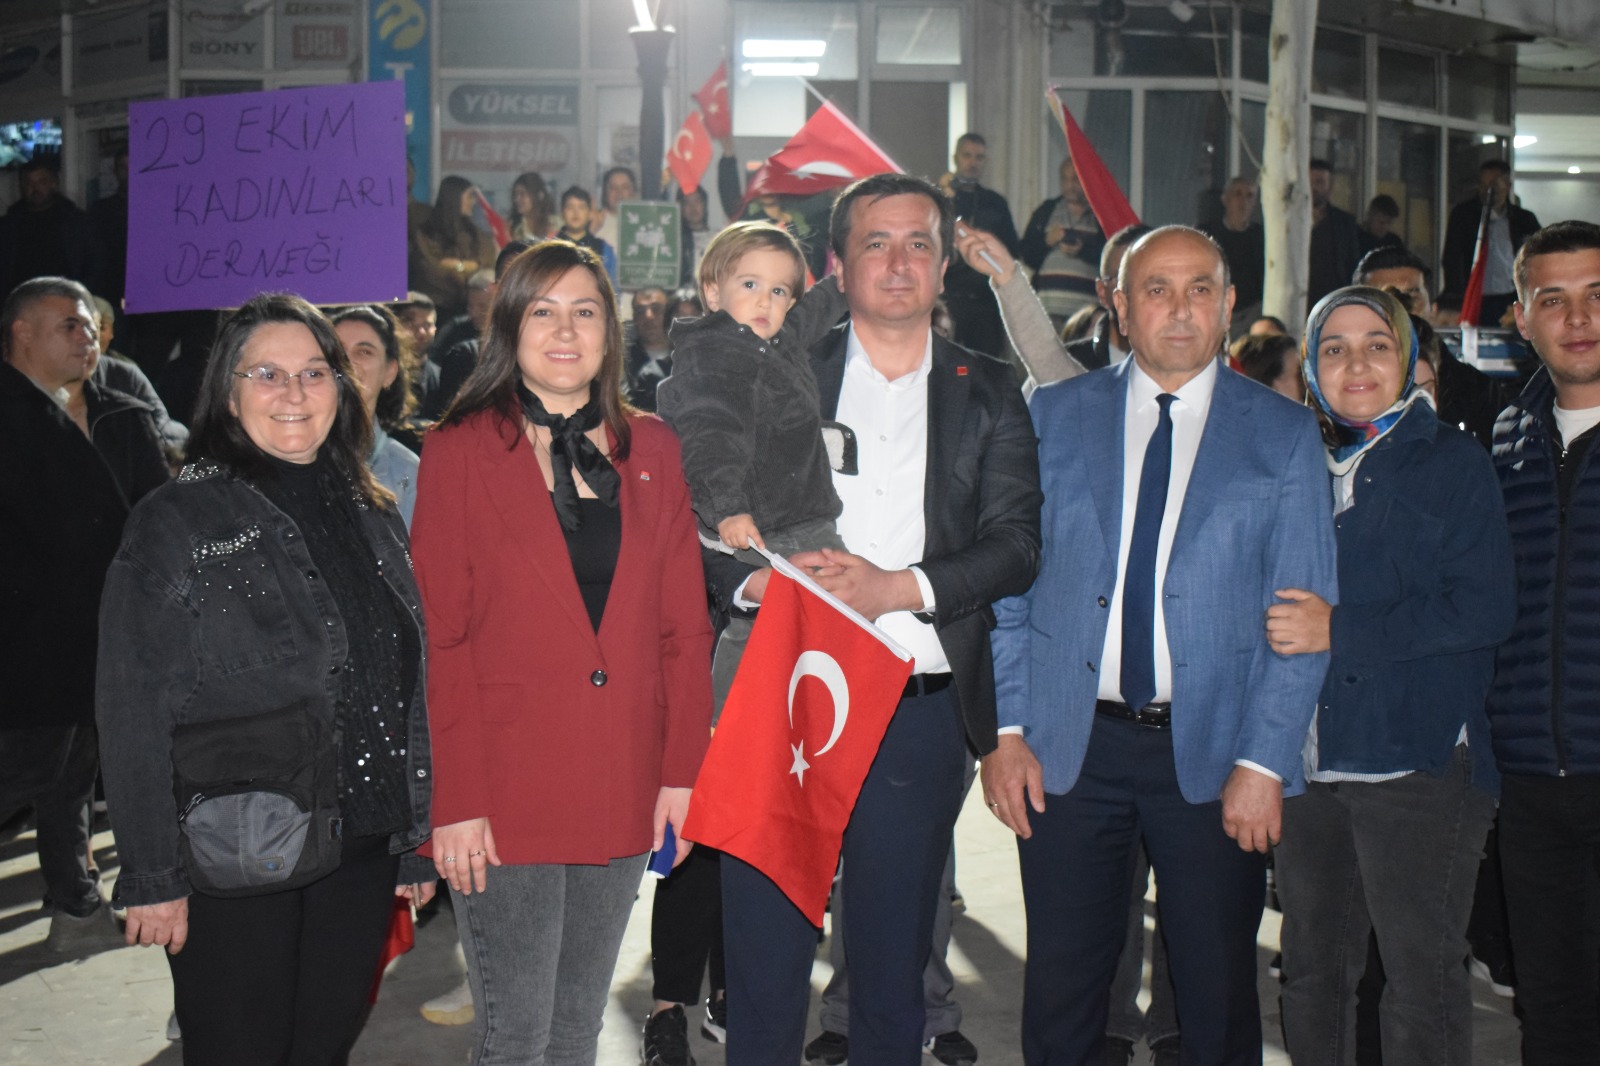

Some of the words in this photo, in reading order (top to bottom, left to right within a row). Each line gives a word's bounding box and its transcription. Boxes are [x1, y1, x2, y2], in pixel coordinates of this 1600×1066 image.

[189, 41, 258, 55] SONY
[298, 29, 342, 56] JBL
[464, 89, 572, 115] YÜKSEL
[138, 111, 205, 174] 29
[235, 96, 359, 157] EKİM
[446, 137, 568, 166] İLETİŞİM
[173, 165, 395, 226] KADINLARI
[164, 231, 342, 288] DERNEĞİ
